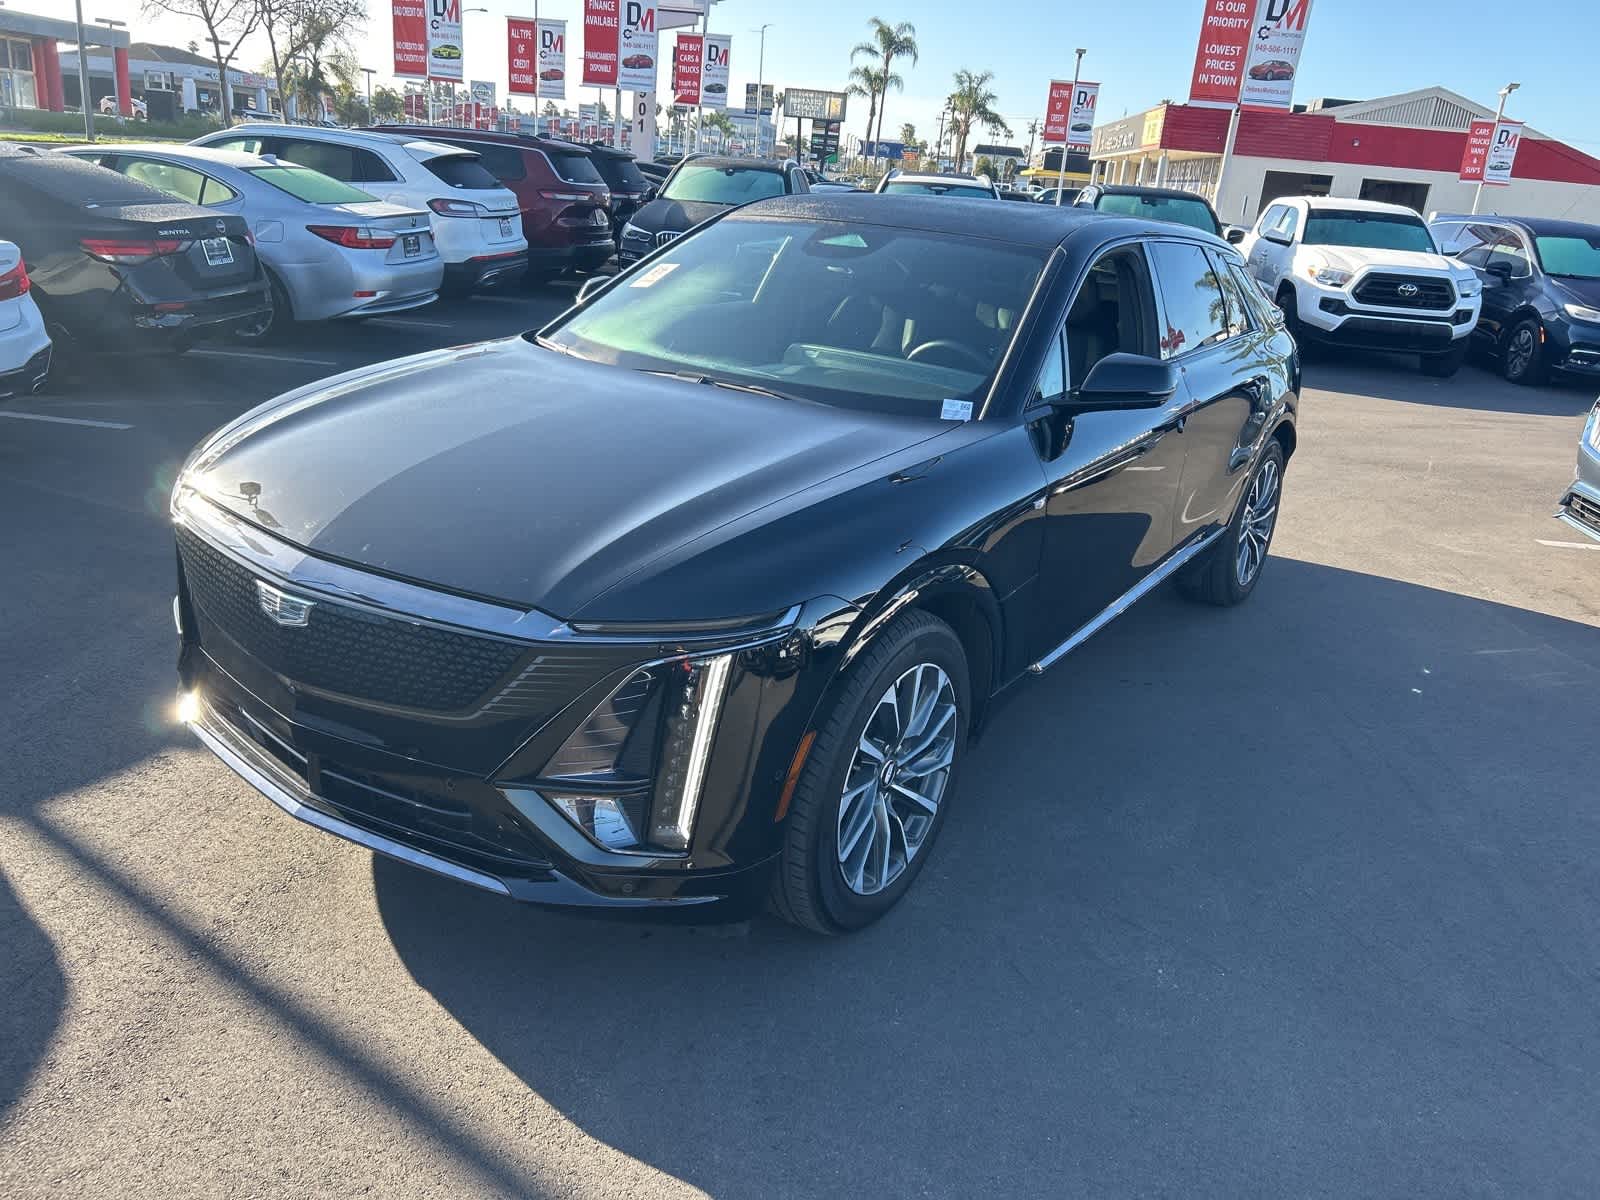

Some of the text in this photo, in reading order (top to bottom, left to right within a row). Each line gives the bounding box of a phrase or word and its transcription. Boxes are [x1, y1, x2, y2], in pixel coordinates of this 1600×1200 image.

[588, 0, 615, 11] FINANCE
[1215, 1, 1246, 13] IS OUR
[585, 15, 618, 27] AVAILABLE
[627, 2, 654, 32] DM
[1207, 15, 1250, 29] PRIORITY
[511, 28, 532, 40] ALL TYPE
[517, 43, 525, 54] OF
[679, 42, 700, 52] WE BUY
[1205, 43, 1242, 56] LOWEST
[680, 54, 699, 63] CARS &
[679, 65, 700, 74] TRUCKS
[1205, 59, 1236, 71] PRICES
[1198, 73, 1237, 86] IN TOWN
[1055, 102, 1062, 110] OF
[1475, 128, 1490, 136] CARS
